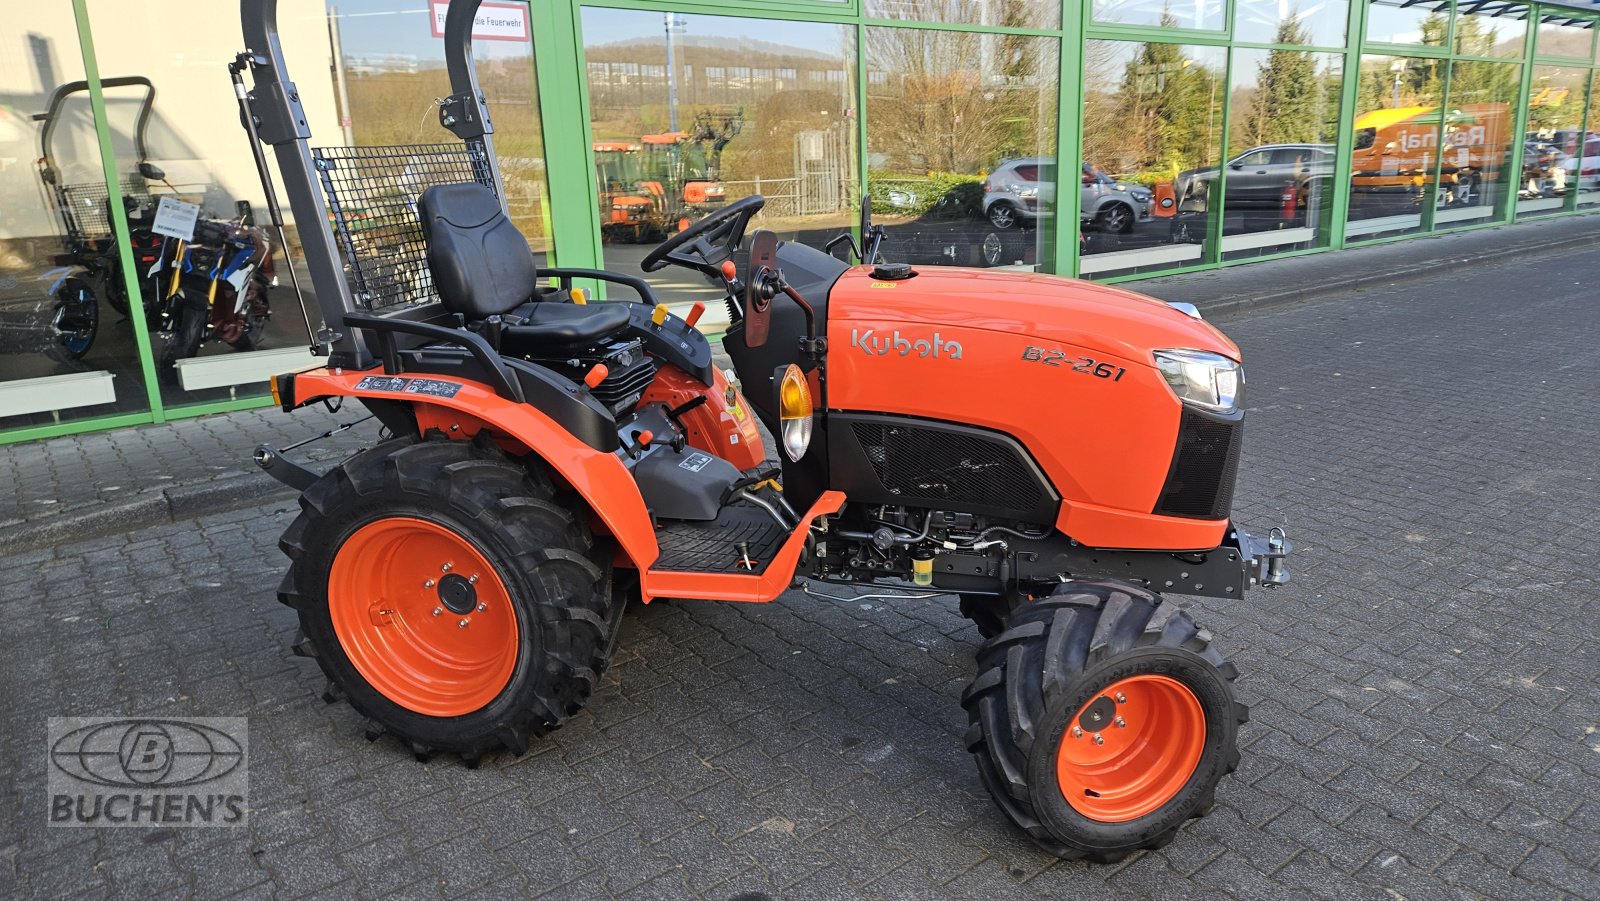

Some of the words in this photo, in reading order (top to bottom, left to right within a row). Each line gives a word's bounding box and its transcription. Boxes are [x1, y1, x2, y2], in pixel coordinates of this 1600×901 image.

[474, 16, 485, 26] die
[486, 17, 522, 28] Feuerwehr
[851, 328, 963, 360] Kubota
[1021, 345, 1127, 382] B2-261
